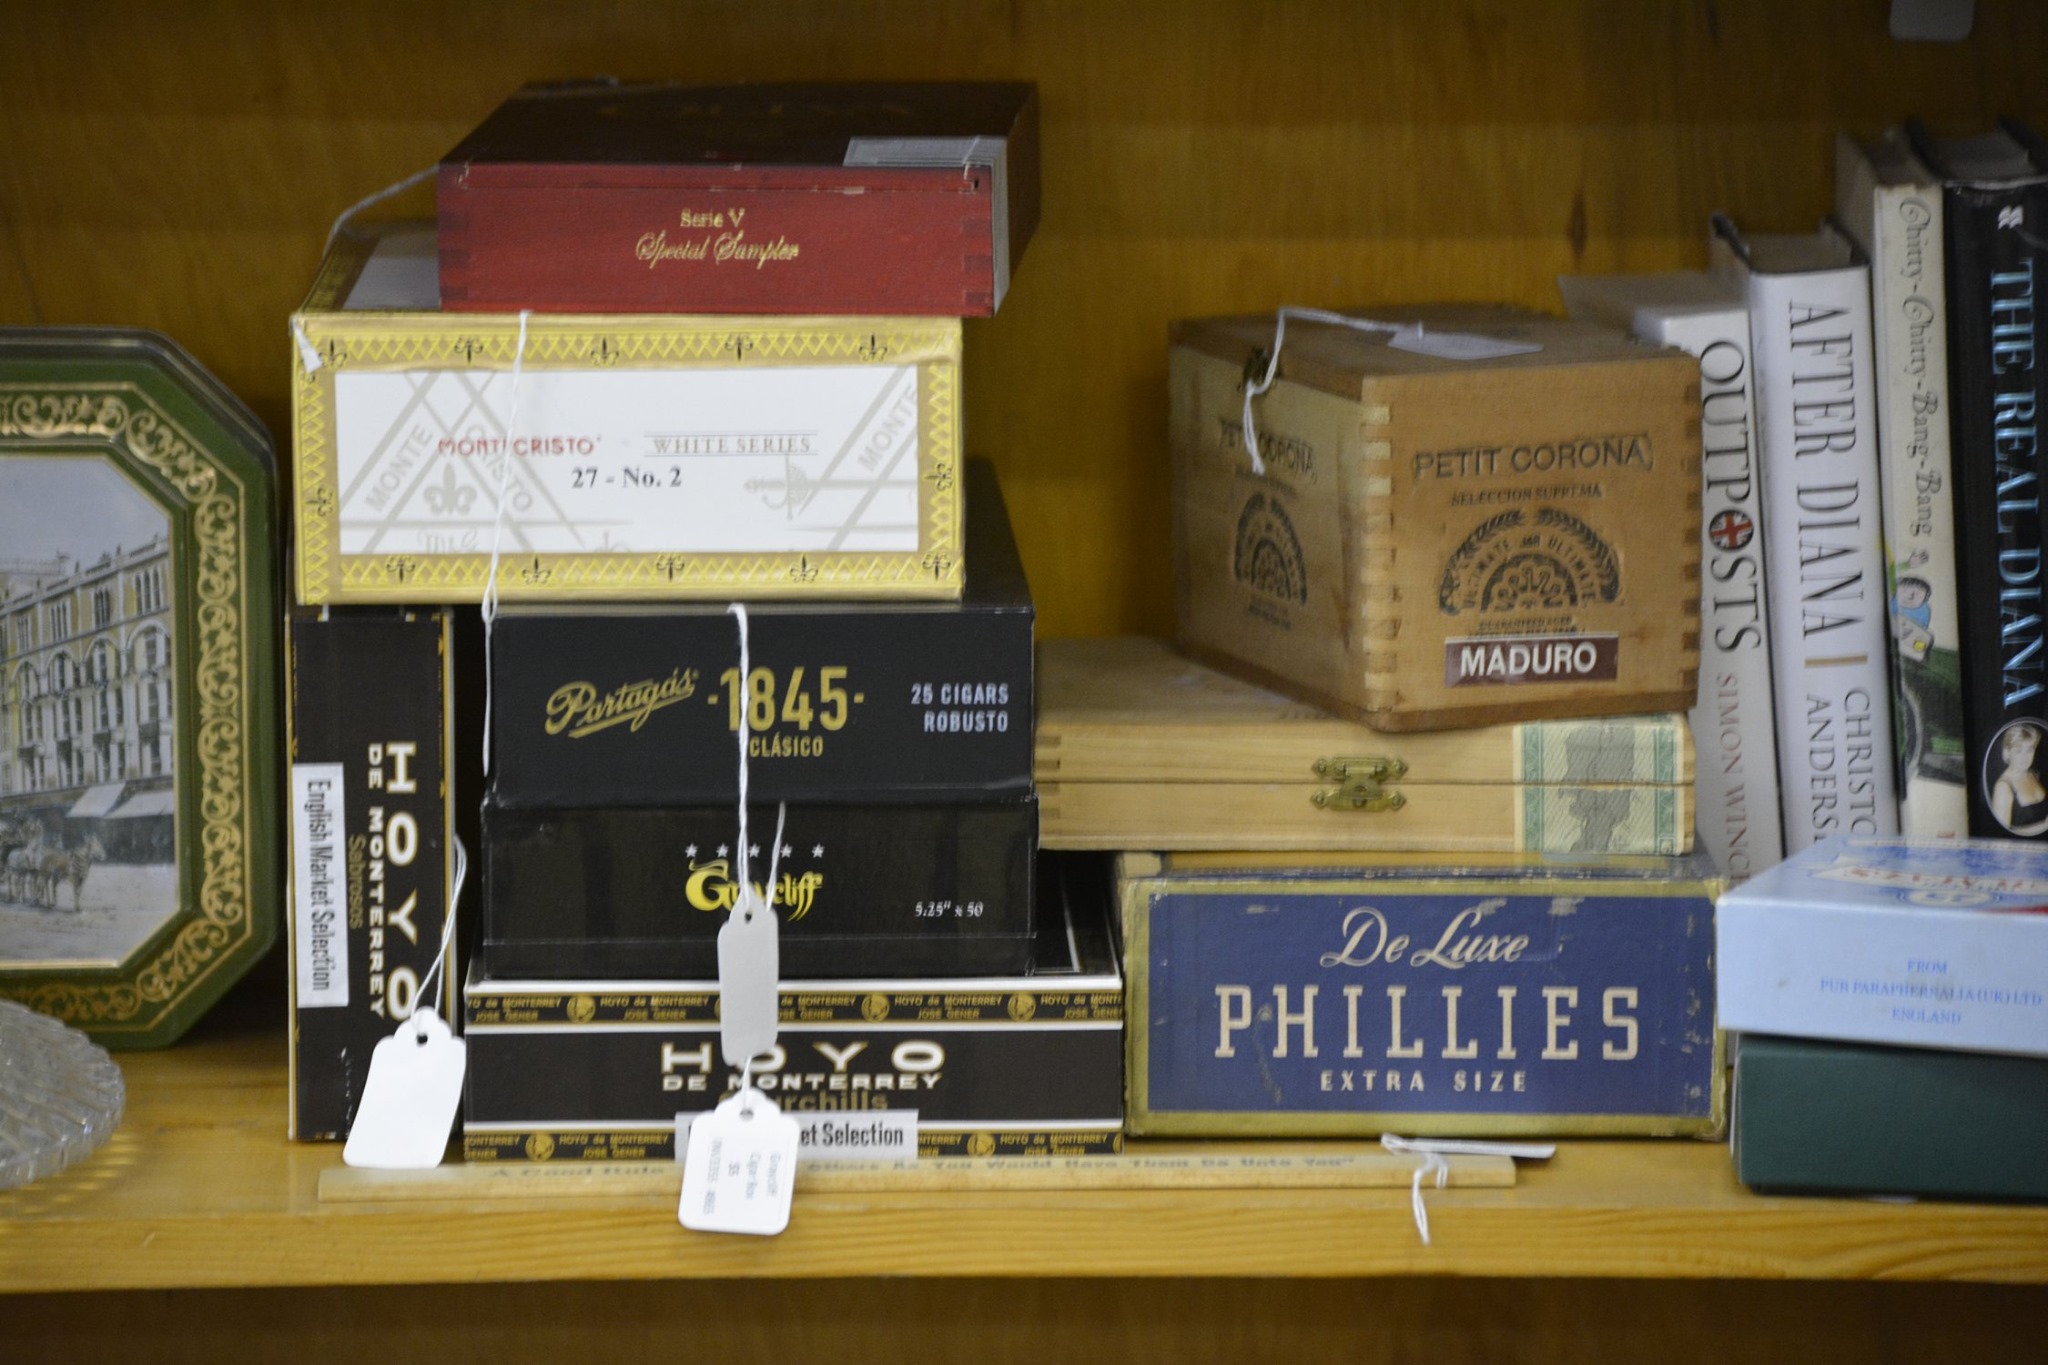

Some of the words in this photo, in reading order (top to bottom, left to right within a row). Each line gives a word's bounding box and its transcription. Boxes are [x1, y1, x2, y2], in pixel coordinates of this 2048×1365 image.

[680, 208, 723, 228] Serie
[728, 208, 746, 228] V
[635, 230, 711, 269] Special
[713, 230, 799, 269] Sampler
[1990, 257, 2036, 375] THE
[1789, 298, 1858, 460] AFTER
[653, 436, 730, 455] WHITE
[736, 434, 811, 454] SERIES
[1415, 448, 1502, 480] PETIT
[1511, 437, 1646, 473] CORONA
[1994, 387, 2039, 533] REAL
[571, 467, 598, 489] 27
[621, 467, 662, 488] No.
[669, 466, 682, 487] 2
[1797, 478, 1864, 640] DIANA
[1998, 544, 2046, 710] DIANA
[1460, 641, 1598, 677] MADURO
[911, 683, 933, 705] 25
[940, 683, 1009, 705] CIGARS
[749, 732, 824, 757] CLÁSICO
[923, 710, 1009, 732] ROBUSTO
[1716, 671, 1743, 775] SIMON
[367, 743, 384, 789] DE
[304, 778, 332, 843] English
[310, 846, 333, 906] Market
[349, 833, 367, 929] Sabrosos
[386, 741, 419, 1022] HOYO
[368, 806, 385, 1020] MONTERREY
[311, 908, 337, 991] Selection
[1319, 906, 1411, 968] De
[1410, 906, 1530, 970] Luxe
[1907, 959, 1949, 974] FROM
[600, 995, 630, 1008] HOYO
[894, 994, 924, 1007] HOYO
[944, 993, 1002, 1008] MONTERREY
[1040, 993, 1069, 1006] HOYO
[1853, 979, 1974, 1002] PARAPHERNALIA
[2013, 989, 2043, 1006] LTD
[1214, 984, 1640, 1060] PHILLIES
[1891, 1007, 1962, 1026] ENGLAND
[662, 1074, 708, 1091] DE
[727, 1073, 944, 1091] MONTERREY
[1320, 1070, 1425, 1092] EXTRA
[1453, 1070, 1527, 1092] SIZE
[559, 1134, 589, 1146] HOYO
[610, 1133, 669, 1147] MONTERREY
[822, 1121, 904, 1147] Selection
[1000, 1134, 1030, 1145] HOYO
[1050, 1132, 1108, 1146] MONTERREY
